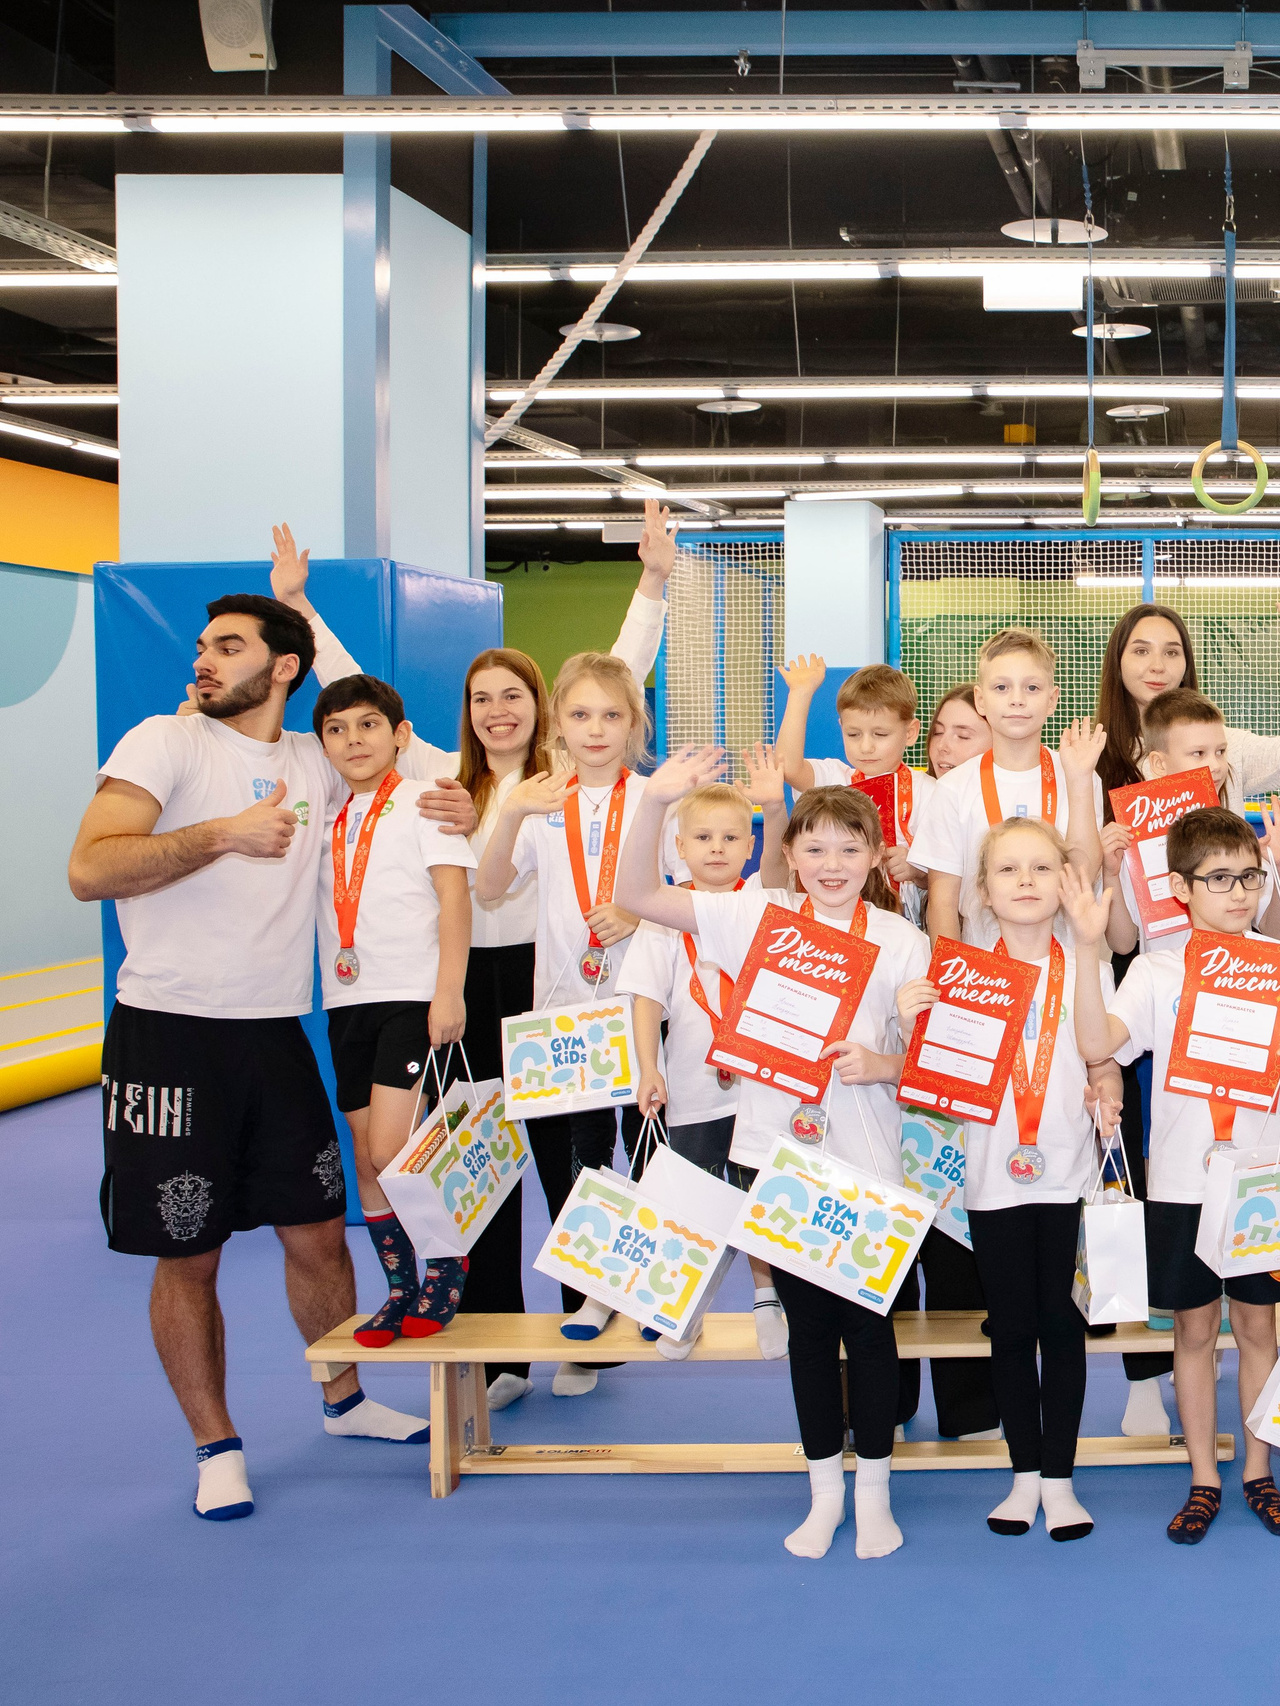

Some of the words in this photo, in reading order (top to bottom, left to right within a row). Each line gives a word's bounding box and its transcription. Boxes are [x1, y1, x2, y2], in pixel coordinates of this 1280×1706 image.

[253, 789, 272, 800] Ki
[778, 956, 851, 984] тест
[777, 982, 818, 1001] НАГРАЖДАЕТСЯ
[948, 985, 1016, 1007] тест
[949, 1012, 986, 1027] НАГРАЖДАЕТСЯ
[1216, 1002, 1256, 1014] НАГРАЖДАЕТСЯ
[550, 1035, 586, 1053] GYM
[552, 1050, 587, 1068] KiDs
[463, 1139, 486, 1169] GYM
[469, 1151, 491, 1180] KiDs
[817, 1195, 859, 1227] GYM
[811, 1210, 854, 1241] KiDs
[619, 1224, 657, 1255] GYM
[611, 1238, 651, 1269] KiDs
